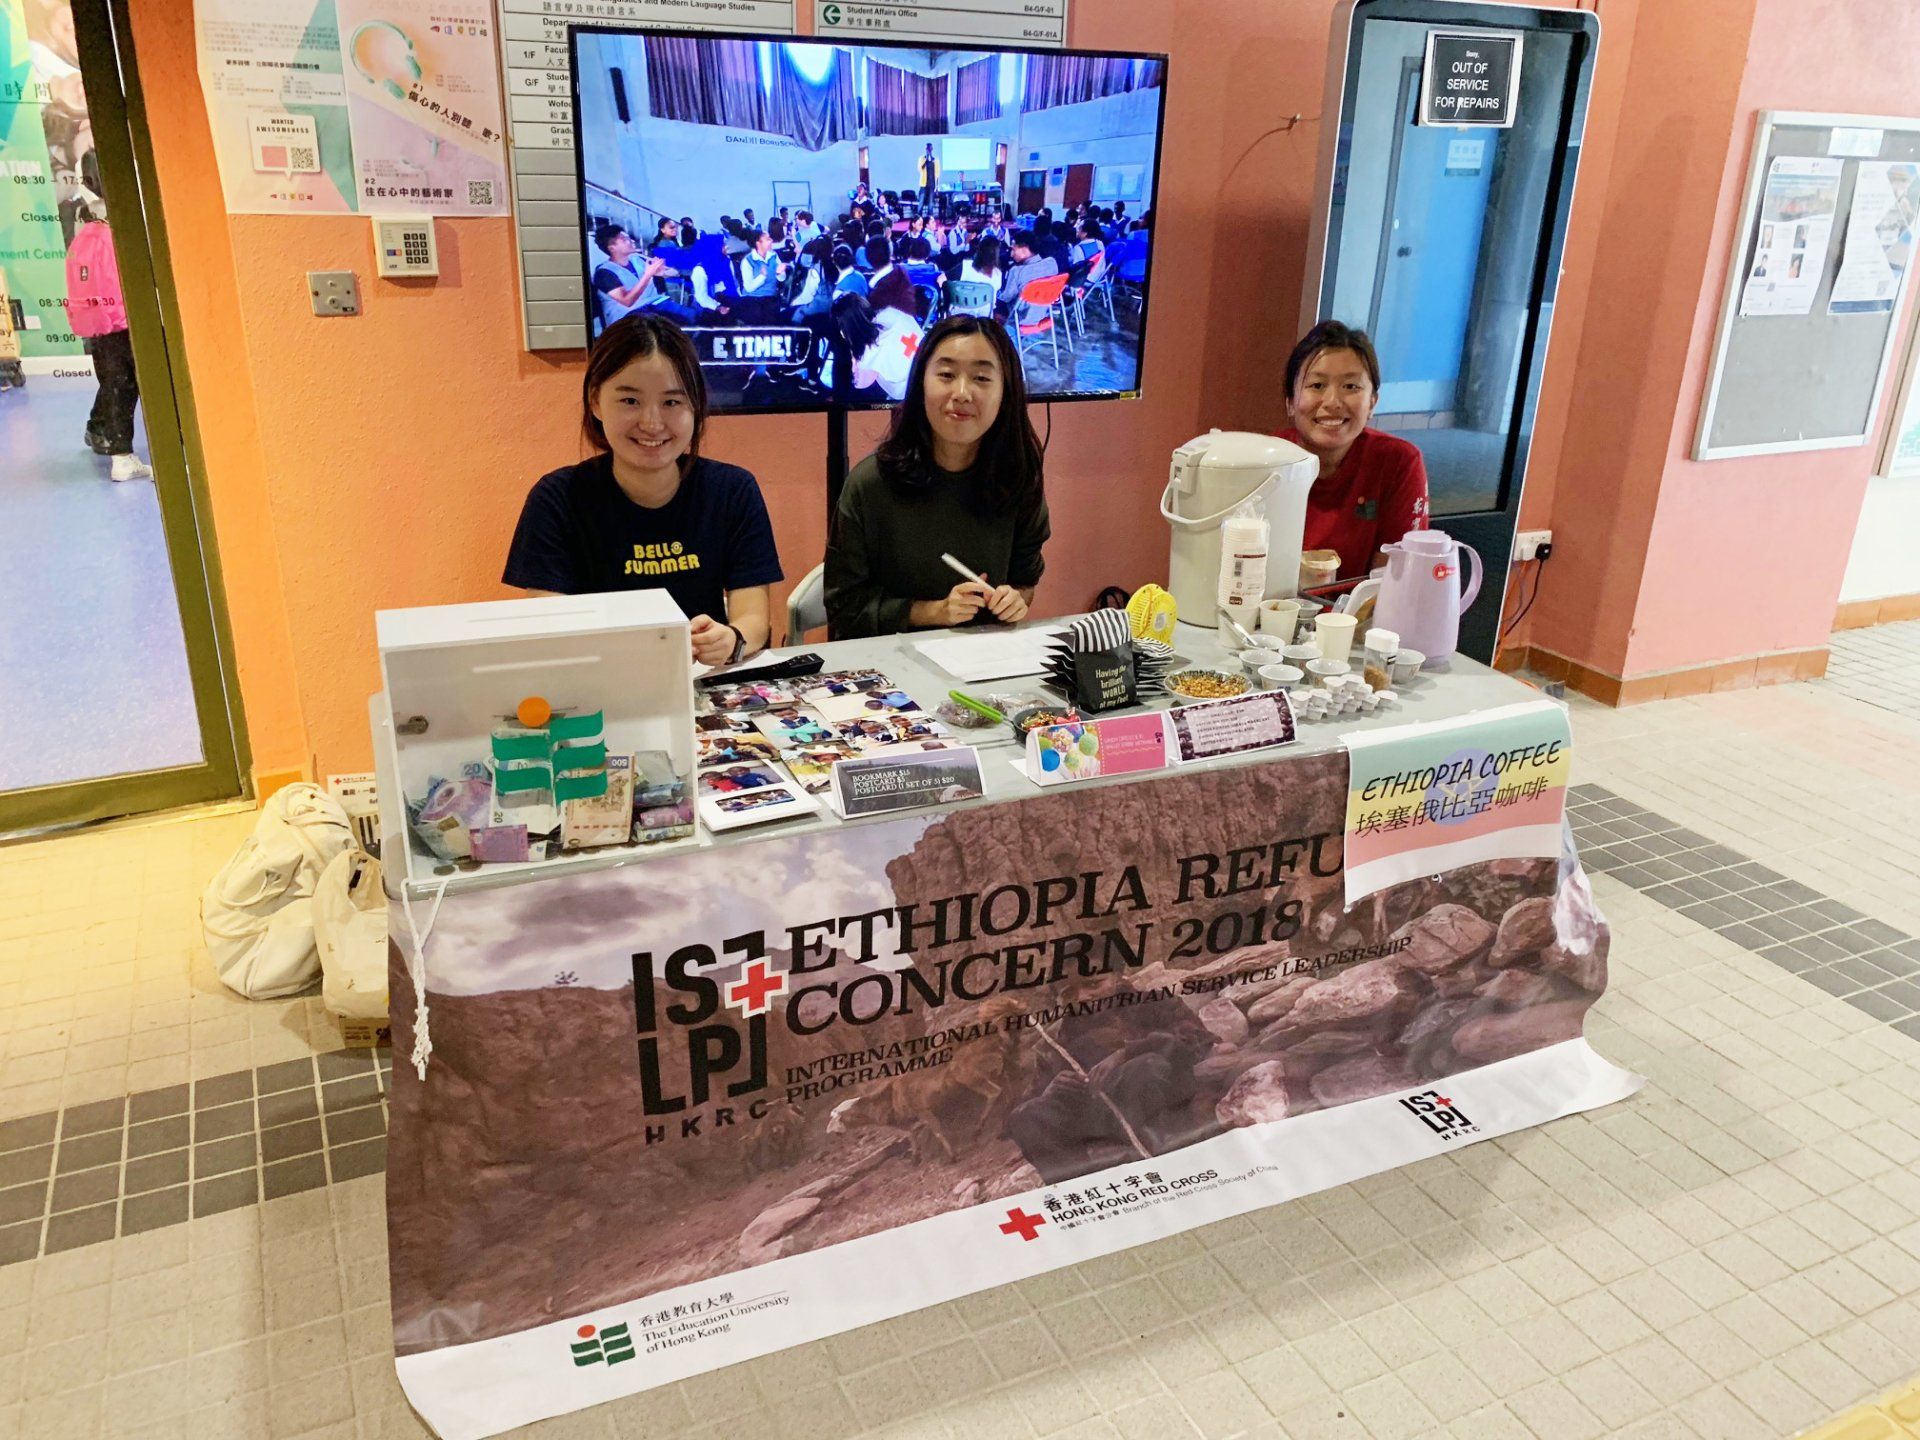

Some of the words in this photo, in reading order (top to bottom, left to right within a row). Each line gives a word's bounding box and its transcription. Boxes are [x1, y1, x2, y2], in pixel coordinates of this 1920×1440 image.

[728, 2, 756, 11] Studies
[846, 6, 873, 15] Student
[875, 7, 896, 16] Affairs
[897, 9, 918, 17] Office
[523, 51, 536, 59] 1/F
[1451, 61, 1473, 74] OUT
[1474, 62, 1489, 74] OF
[525, 78, 540, 87] G/F
[1446, 78, 1490, 91] SERVICE
[1434, 96, 1455, 108] FOR
[1457, 96, 1500, 109] REPAIRS
[13, 175, 46, 185] 08:30
[21, 212, 61, 223] Closed
[39, 298, 70, 308] 08:30
[45, 333, 77, 343] 09:00
[733, 336, 792, 358] TIME!
[53, 369, 92, 378] Closed
[633, 541, 684, 559] BELLO
[624, 554, 701, 575] SUMMER
[1102, 684, 1126, 699] WORLD
[463, 762, 481, 775] 20
[852, 770, 898, 783] BOOKMARK
[1361, 758, 1474, 802] ETHIOPIA
[1479, 739, 1562, 780] COFFEE
[853, 777, 896, 789] POSTCARD
[855, 783, 897, 796] POSTCARD
[906, 780, 920, 789] SET
[922, 778, 932, 787] OF
[1354, 776, 1550, 839] 埃塞俄比亞咖啡
[785, 864, 1154, 975] ETHIOPIA
[785, 922, 1154, 1036] CONCERN
[1167, 899, 1303, 962] 2018
[785, 1020, 999, 1086] INTERNATIONAL
[1003, 983, 1179, 1032] HUMANITRIAN
[1180, 967, 1279, 997] SERVICE
[1281, 936, 1412, 976] LEADERSHIP
[785, 1047, 954, 1104] PROGRAMME
[1043, 1171, 1164, 1212] 香港紅十字會
[1052, 1205, 1095, 1224] HONG
[1096, 1192, 1139, 1211] KONG
[1140, 1184, 1169, 1198] RED
[1170, 1169, 1218, 1190] CROSS
[1122, 1200, 1152, 1215] Branch
[1153, 1198, 1161, 1206] of
[1162, 1195, 1175, 1203] the
[1176, 1188, 1194, 1199] Red
[1194, 1183, 1218, 1194] Cross
[1218, 1174, 1247, 1187] Society
[1248, 1169, 1256, 1178] of
[1256, 1164, 1279, 1174] China
[638, 1291, 735, 1328] 香港教育大學
[643, 1329, 667, 1343] The
[668, 1312, 729, 1337] Education
[730, 1295, 790, 1319] University
[646, 1342, 660, 1354] of
[661, 1331, 696, 1350] Hong
[698, 1323, 732, 1342] Kong
